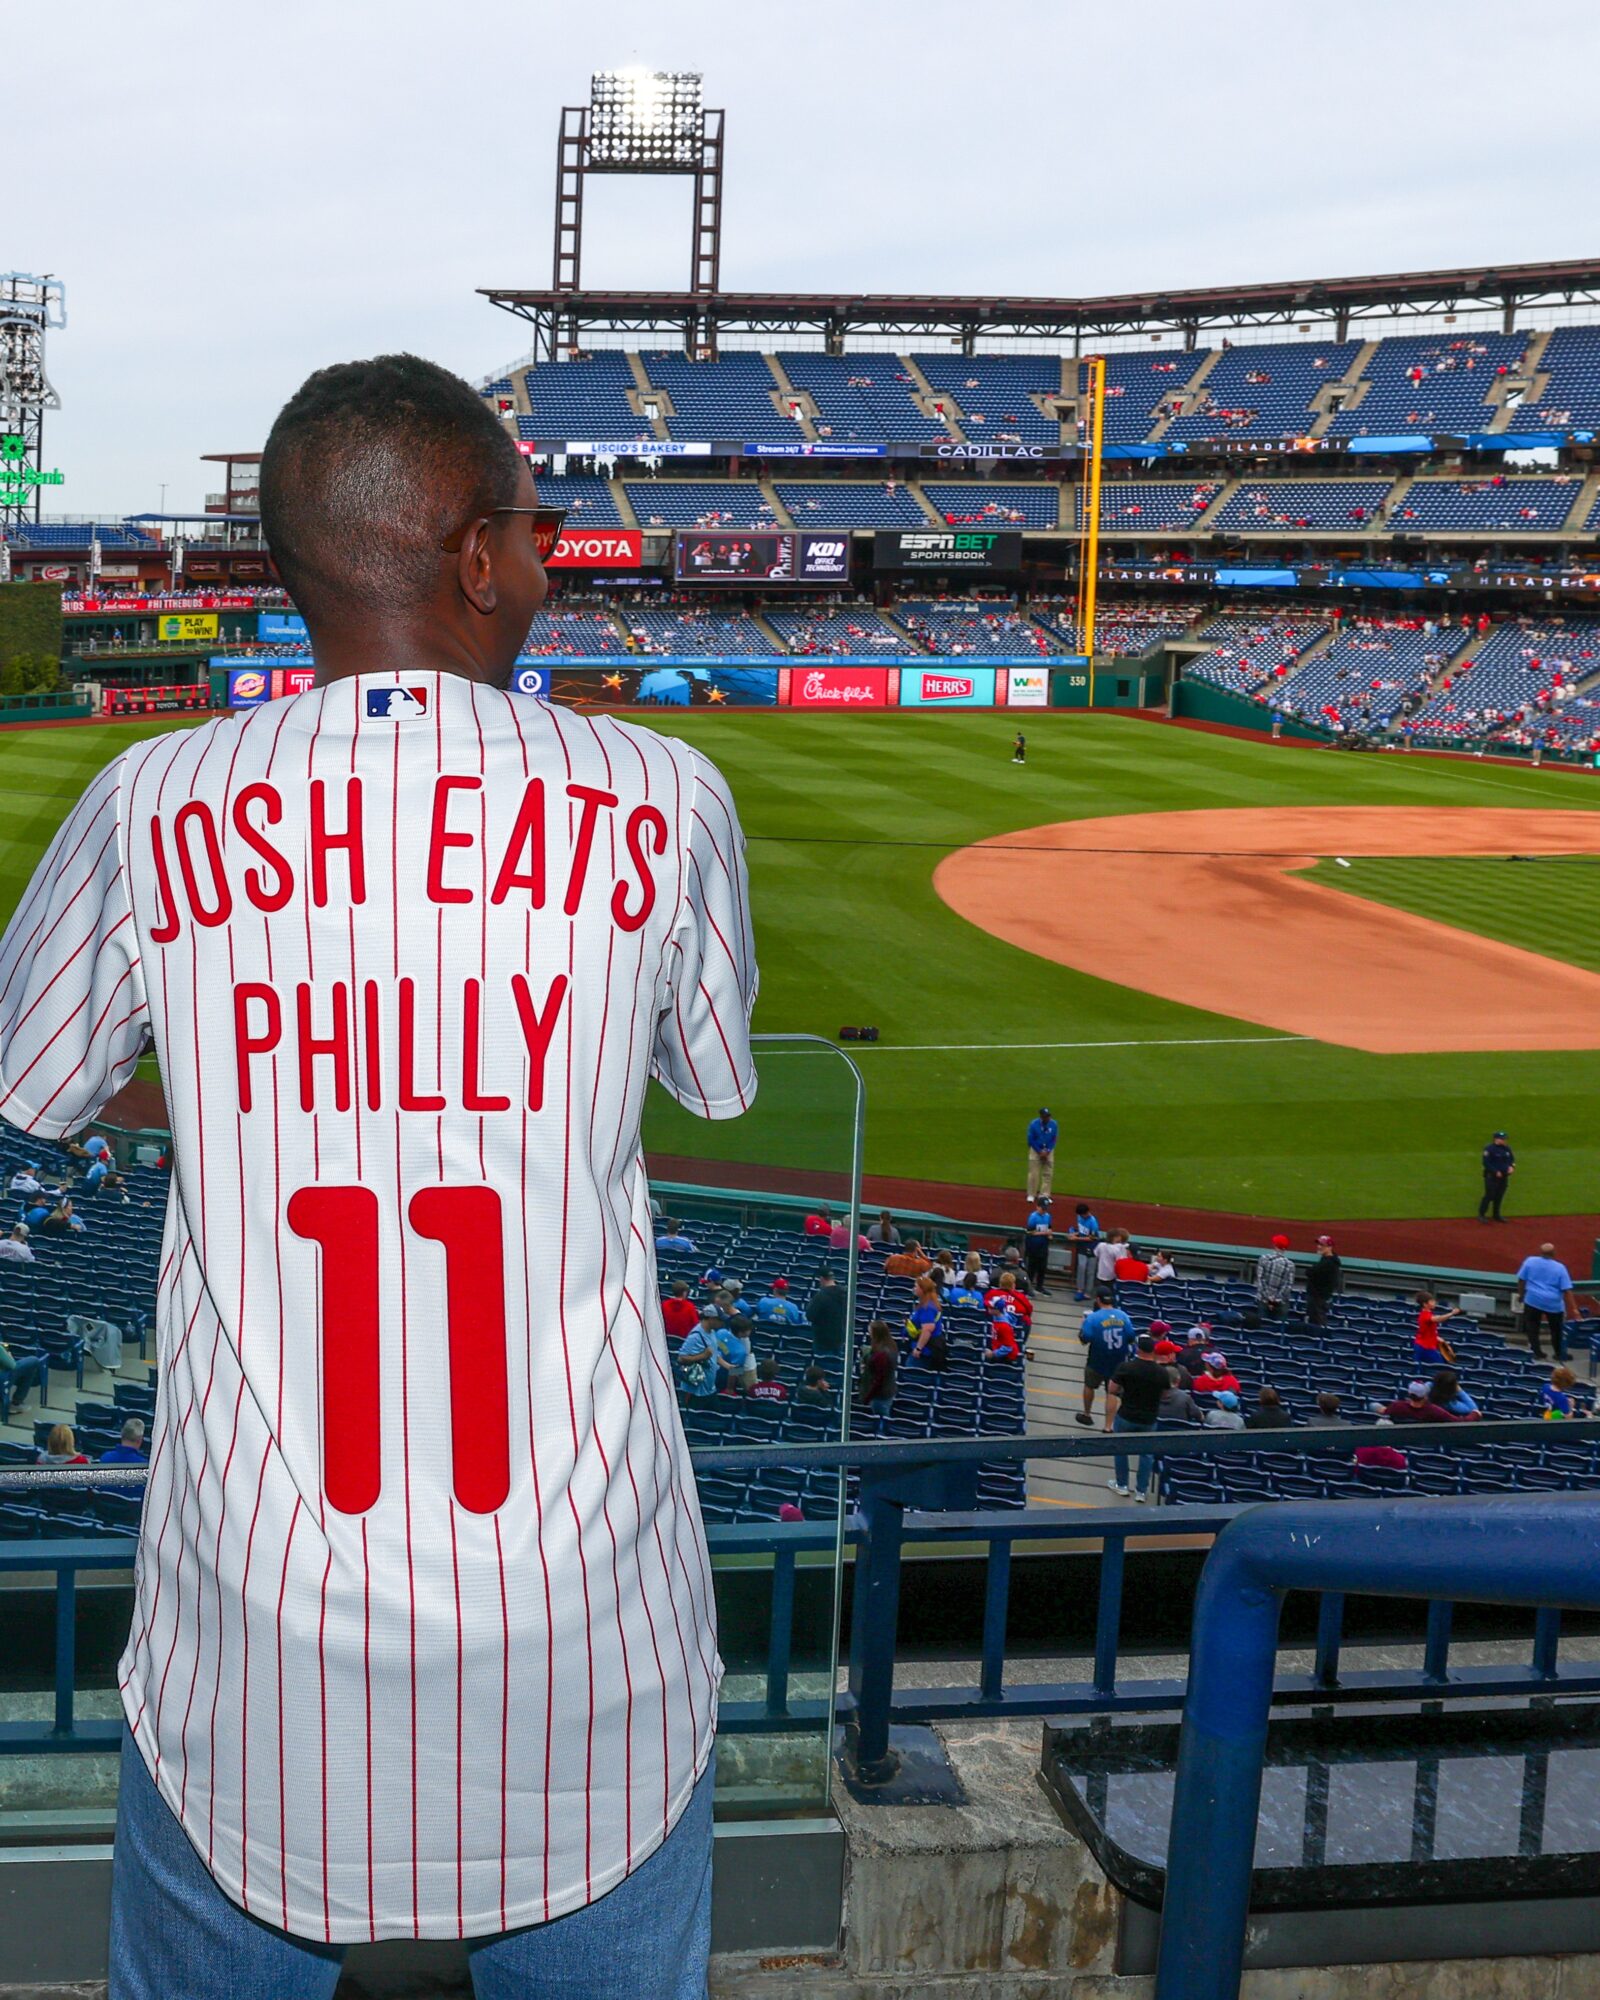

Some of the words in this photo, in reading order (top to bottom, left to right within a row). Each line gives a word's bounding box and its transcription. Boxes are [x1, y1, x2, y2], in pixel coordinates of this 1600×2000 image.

[591, 443, 638, 453] LISCIO'S
[642, 443, 686, 453] BAKERY
[757, 444, 785, 453] Stream
[937, 445, 1044, 457] CADILLAC
[25, 467, 64, 484] Bank
[553, 539, 633, 557] OYOTA
[900, 534, 955, 549] ESPN
[955, 534, 998, 549] BET
[806, 542, 845, 557] KDI
[910, 551, 986, 559] SPORTSBOOK
[814, 557, 836, 565] OFFICE
[805, 564, 845, 572] TECHNOLOGY
[184, 617, 204, 627] PLAY
[925, 679, 968, 694] HERR'S
[1013, 677, 1043, 688] WM
[1070, 676, 1086, 687] 330
[149, 777, 367, 943] JOSH
[427, 775, 668, 932] EATS
[234, 974, 569, 1113] PHILLY
[1103, 1327, 1124, 1350] 45
[287, 1186, 510, 1514] 11
